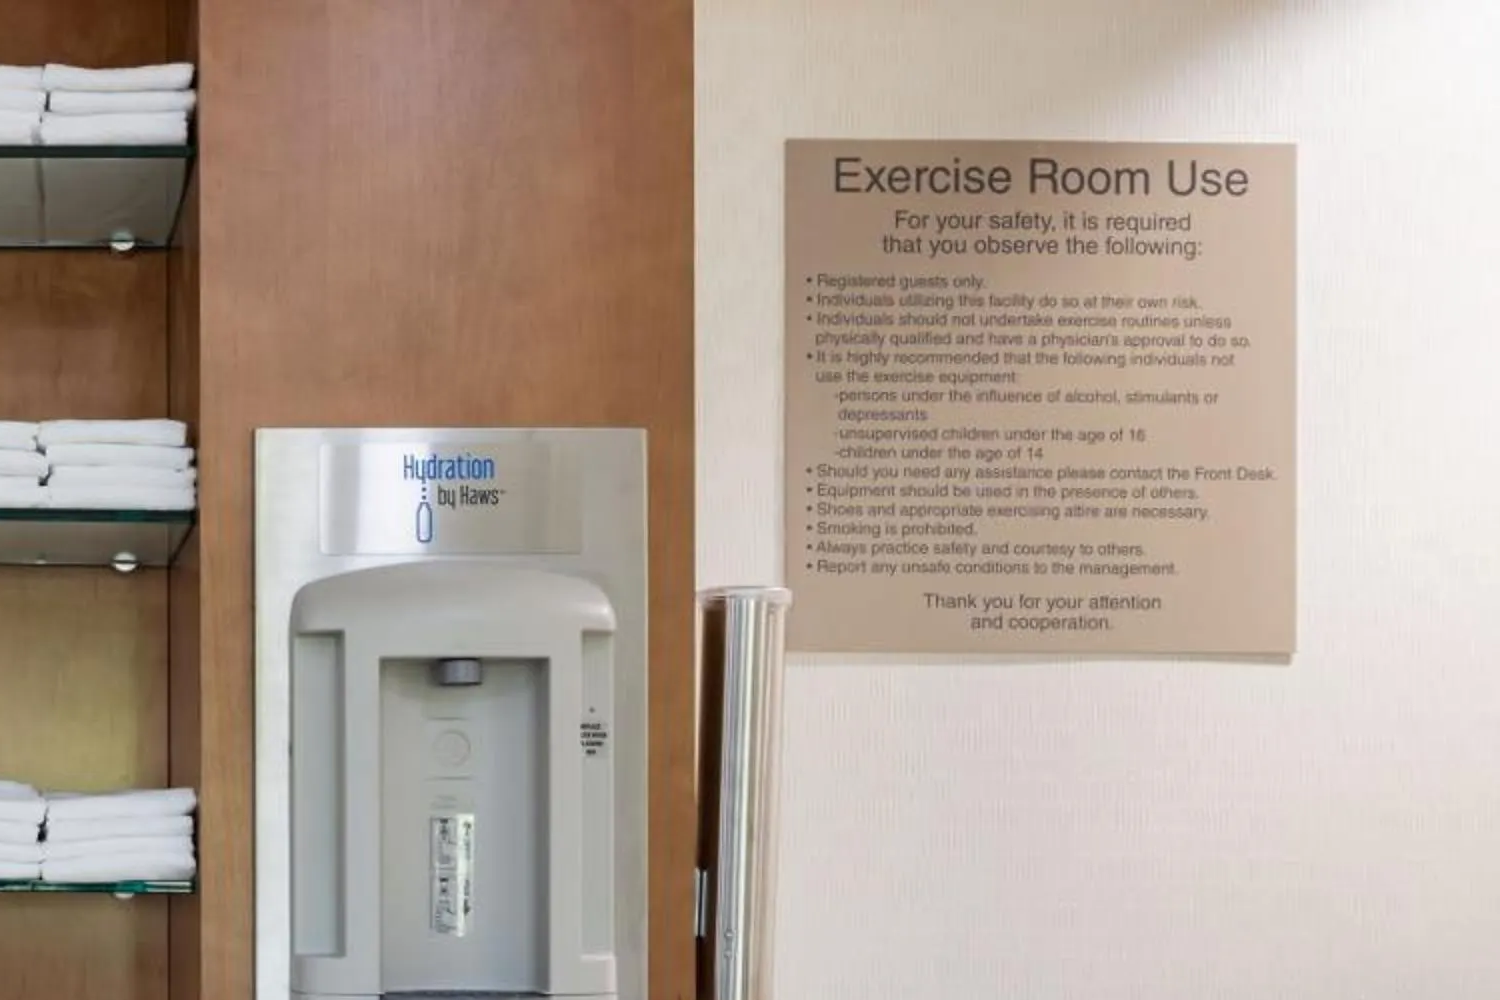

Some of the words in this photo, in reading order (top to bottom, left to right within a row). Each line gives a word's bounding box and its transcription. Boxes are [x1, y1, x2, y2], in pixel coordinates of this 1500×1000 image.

[833, 157, 1013, 194] Exercise
[1029, 159, 1150, 195] Room
[1167, 160, 1250, 196] Use
[894, 210, 930, 229] For
[935, 215, 983, 235] your
[988, 210, 1057, 233] safety,
[1062, 211, 1079, 229] it
[1081, 211, 1100, 230] is
[1104, 213, 1192, 236] required
[882, 236, 925, 253] that
[928, 240, 968, 258] you
[973, 237, 1060, 253] observe
[1065, 238, 1098, 254] the
[1104, 237, 1203, 259] following:
[816, 274, 896, 290] Registered
[900, 274, 948, 291] guests
[817, 293, 895, 307] Individuals
[959, 294, 985, 307] this
[1039, 294, 1057, 308] do
[1061, 297, 1079, 308] so
[1083, 295, 1097, 308] at
[816, 313, 894, 326] Individuals
[898, 313, 948, 327] should
[952, 313, 975, 327] not
[1057, 314, 1117, 328] exercise
[1121, 315, 1180, 328] routines
[1183, 315, 1232, 328] unless
[815, 332, 886, 348] physically
[889, 332, 950, 348] qualified
[955, 332, 984, 346] and
[989, 332, 1024, 346] have
[1028, 335, 1036, 346] a
[1123, 333, 1186, 350] approval
[1189, 334, 1203, 347] to
[1207, 334, 1226, 347] do
[816, 350, 826, 363] It
[830, 350, 842, 363] is
[846, 350, 890, 366] highly
[893, 351, 999, 364] recommended
[1003, 351, 1031, 364] that
[1034, 351, 1059, 365] the
[1062, 351, 1126, 368] following
[1130, 352, 1207, 365] individuals
[1210, 352, 1235, 366] not
[815, 372, 842, 383] use
[846, 370, 869, 383] the
[873, 370, 935, 383] exercise
[901, 388, 944, 402] under
[948, 389, 971, 402] the
[975, 389, 1042, 402] influence
[1047, 389, 1061, 403] of
[1203, 393, 1219, 404] or
[837, 407, 928, 424] depressants
[941, 427, 999, 441] children
[1004, 428, 1046, 441] under
[1051, 428, 1073, 441] the
[1077, 431, 1105, 445] age
[1109, 428, 1124, 442] of
[901, 446, 944, 459] under
[948, 446, 971, 459] the
[975, 448, 1003, 462] age
[1007, 446, 1022, 460] of
[1028, 446, 1044, 460] 14
[403, 452, 495, 484] Hydration
[816, 464, 868, 478] Should
[872, 467, 899, 481] you
[903, 465, 940, 478] need
[944, 467, 971, 481] any
[975, 465, 1053, 479] assistance
[1057, 466, 1105, 482] please
[1109, 466, 1164, 479] contact
[1167, 466, 1190, 480] the
[1194, 466, 1232, 480] Front
[437, 485, 456, 509] by
[817, 484, 896, 500] Equipment
[900, 484, 948, 497] should
[953, 484, 971, 498] be
[975, 484, 1013, 498] used
[1017, 485, 1029, 498] in
[1033, 485, 1057, 498] the
[1060, 487, 1127, 501] presence
[1131, 485, 1146, 499] of
[816, 503, 863, 516] Shoes
[867, 503, 896, 517] and
[900, 504, 983, 520] appropriate
[1103, 507, 1127, 518] are
[816, 522, 881, 538] Smoking
[885, 522, 898, 535] is
[816, 541, 867, 557] Always
[871, 541, 929, 557] practice
[933, 541, 977, 558] safety
[981, 542, 1009, 555] and
[1013, 542, 1075, 558] courtesy
[1079, 542, 1093, 556] to
[817, 560, 867, 576] Report
[870, 562, 898, 576] any
[901, 560, 951, 574] unsafe
[955, 561, 1030, 574] conditions
[1033, 561, 1048, 574] to
[1051, 561, 1075, 574] the
[923, 593, 977, 609] Thank
[982, 597, 1013, 612] you
[1019, 594, 1040, 609] for
[1045, 598, 1084, 613] your
[1088, 594, 1162, 610] attention
[970, 614, 1004, 630] and
